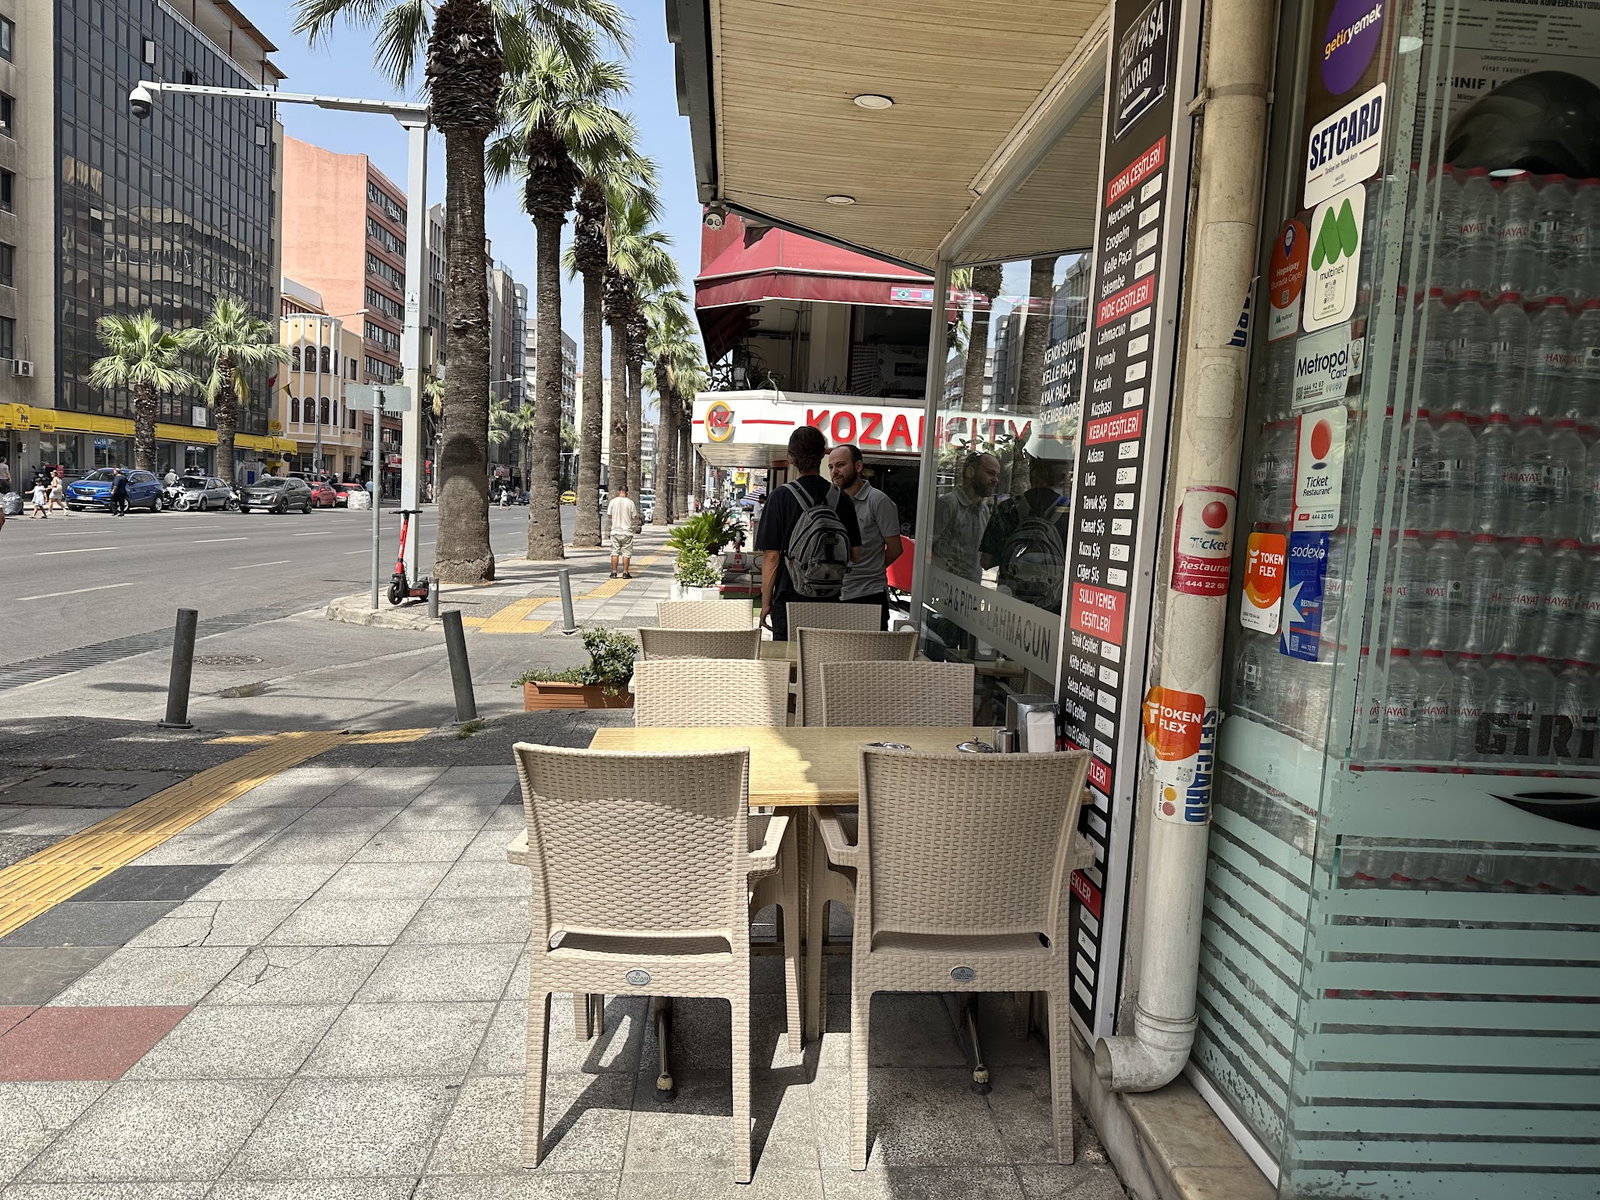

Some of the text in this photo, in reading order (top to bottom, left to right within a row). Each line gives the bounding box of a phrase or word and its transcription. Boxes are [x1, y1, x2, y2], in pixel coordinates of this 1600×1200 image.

[1136, 1, 1163, 56] PAŞA
[1324, 4, 1382, 60] getiryemek
[1120, 53, 1153, 105] BULVARI
[1310, 95, 1382, 171] SETCARD
[1110, 143, 1160, 202] ÇORBA ÇEŞİTLERİ
[1107, 196, 1135, 228] Mercimek
[1106, 225, 1130, 252] Ezogelin
[1500, 227, 1528, 238] HAYAT
[1103, 255, 1118, 276] Kelle
[1118, 248, 1132, 269] Paça
[1320, 264, 1344, 282] multinet
[1101, 274, 1126, 300] İşkembe
[1101, 280, 1149, 322] PİDE ÇEŞİTLERİ
[1098, 322, 1127, 346] Lahmacun
[1044, 331, 1086, 364] KENDİ SUYUND
[1042, 358, 1076, 386] KELLE PAÇA
[1296, 344, 1349, 378] Metropol
[1330, 366, 1348, 380] Card
[1040, 382, 1071, 406] AYAK PAÇA
[1088, 412, 1139, 440] KEBAP ÇEŞİTLERİ
[1086, 448, 1104, 464] Adana
[1084, 472, 1096, 486] Urfa
[1306, 476, 1328, 488] Ticket
[1303, 486, 1332, 496] Restaurant
[1084, 494, 1108, 512] Tavuk Şiş
[1080, 518, 1105, 536] Kanat Şiş
[1078, 542, 1100, 560] Kuzu Şiş
[1260, 552, 1284, 565] TOKEN
[1291, 544, 1326, 560] sodexo
[1076, 564, 1100, 584] Ciğer Şiş
[1180, 560, 1228, 572] Restauran
[1259, 565, 1276, 578] FLEX
[1079, 588, 1116, 612] SULU YEMEK
[1544, 596, 1574, 607] HAYAT
[1080, 610, 1111, 633] ÇEŞİTLERİ
[1072, 632, 1098, 654] Tavuk Çeşitleri
[1080, 658, 1096, 678] Çeşitleri
[1078, 682, 1096, 702] Çeşitleri
[1160, 706, 1201, 724] TOKEN
[1159, 719, 1187, 734] FLEX
[1476, 712, 1600, 758] GİRİ
[1184, 710, 1218, 822] SETCARD
